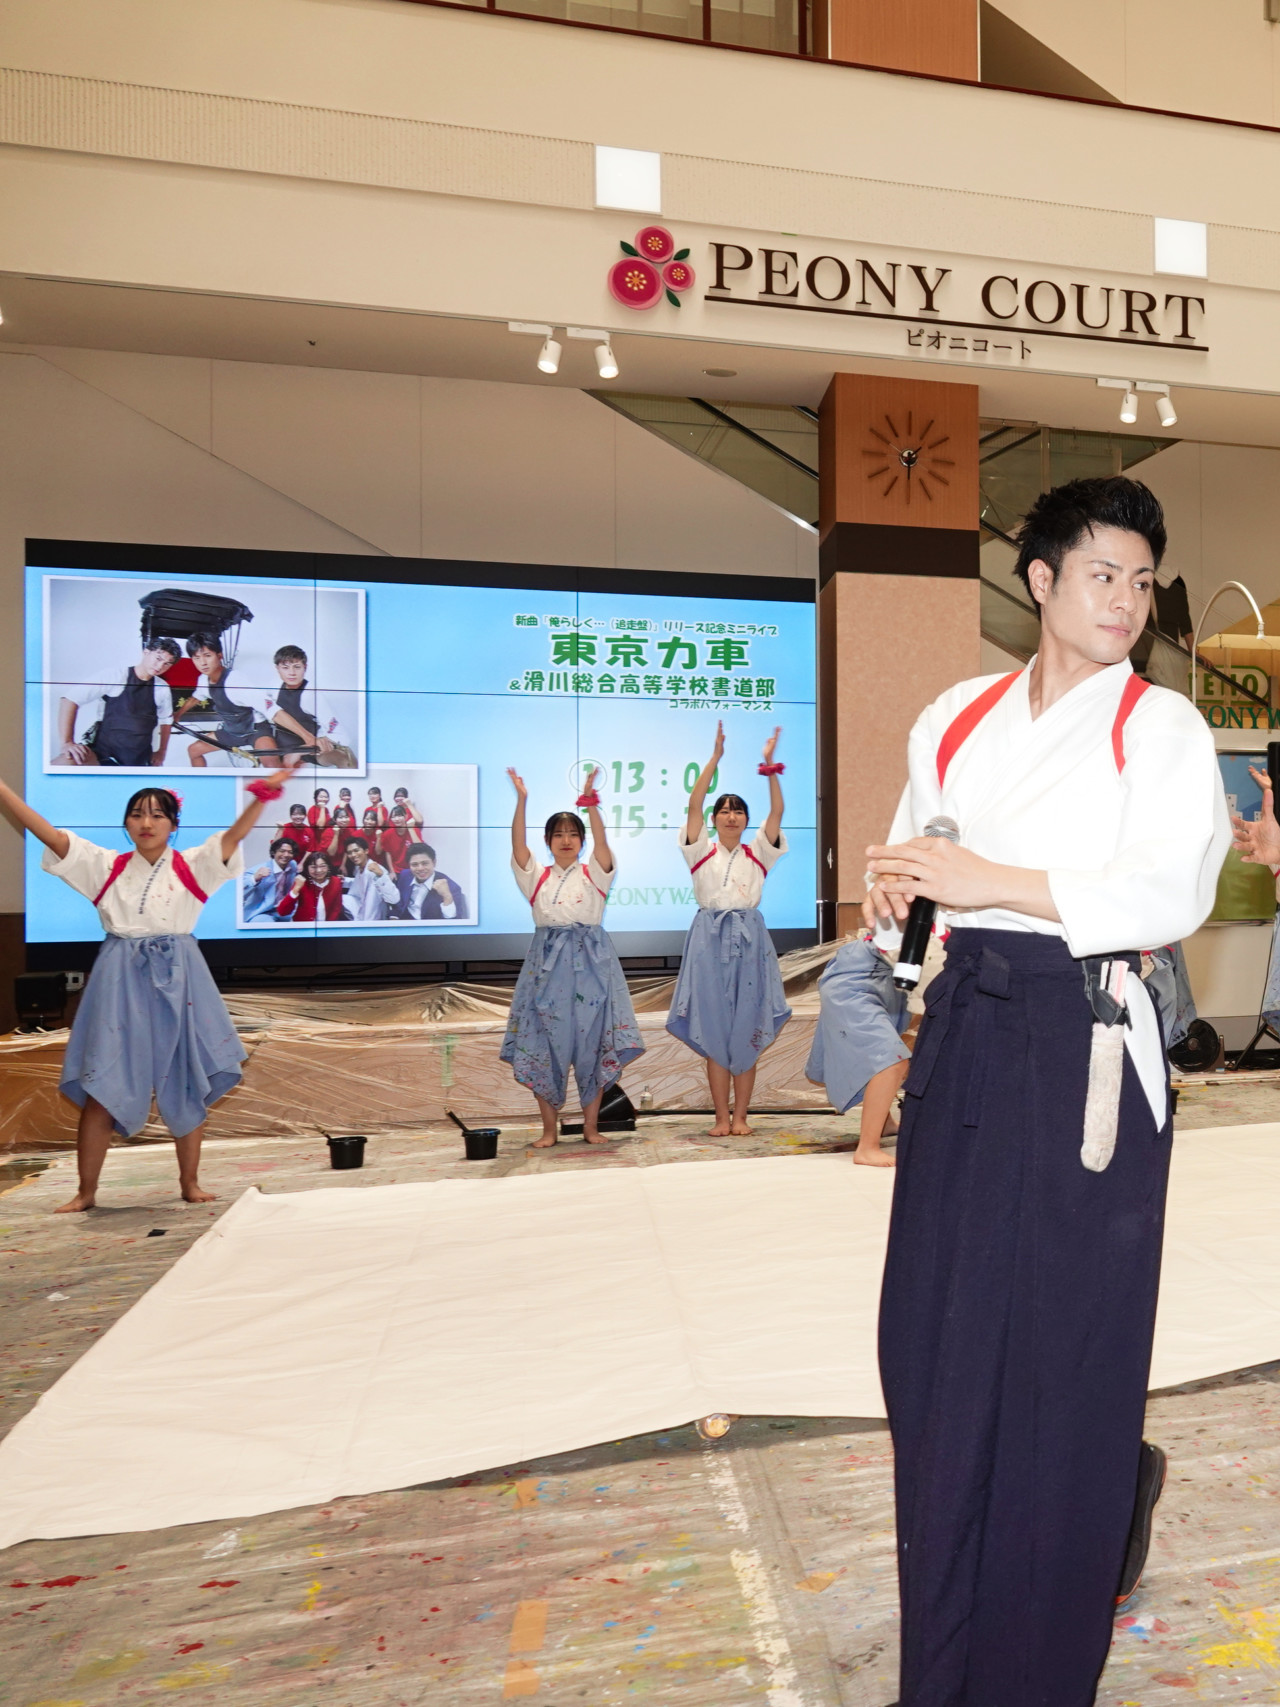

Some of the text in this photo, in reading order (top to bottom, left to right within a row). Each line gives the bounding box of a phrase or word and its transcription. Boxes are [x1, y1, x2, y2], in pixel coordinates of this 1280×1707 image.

[708, 241, 1206, 340] PEONY COURT
[906, 328, 1032, 360] ピオニコート
[550, 632, 750, 671] 東京力車
[606, 887, 699, 906] EONYWA
